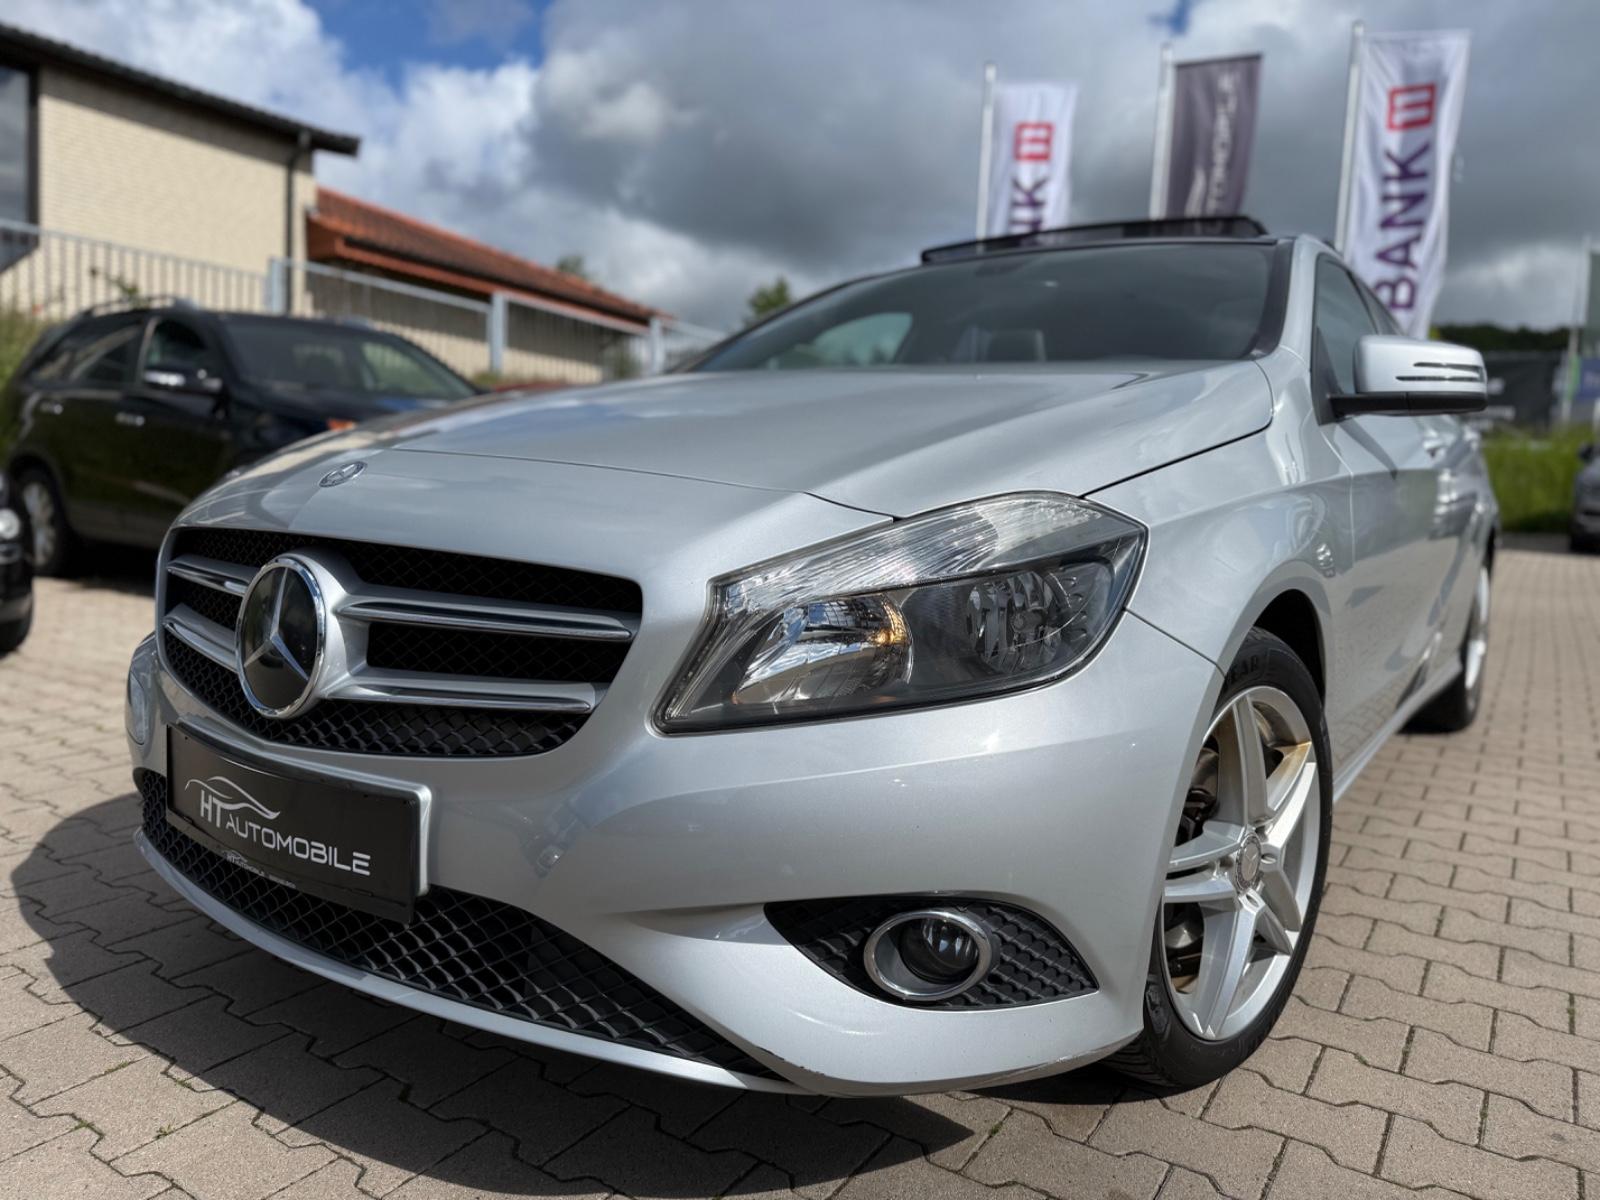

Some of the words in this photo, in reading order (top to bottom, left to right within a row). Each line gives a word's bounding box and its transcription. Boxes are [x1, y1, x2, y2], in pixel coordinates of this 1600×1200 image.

[1374, 142, 1431, 310] BANK
[200, 789, 224, 829] HT
[225, 813, 371, 876] AUTOMOBILE
